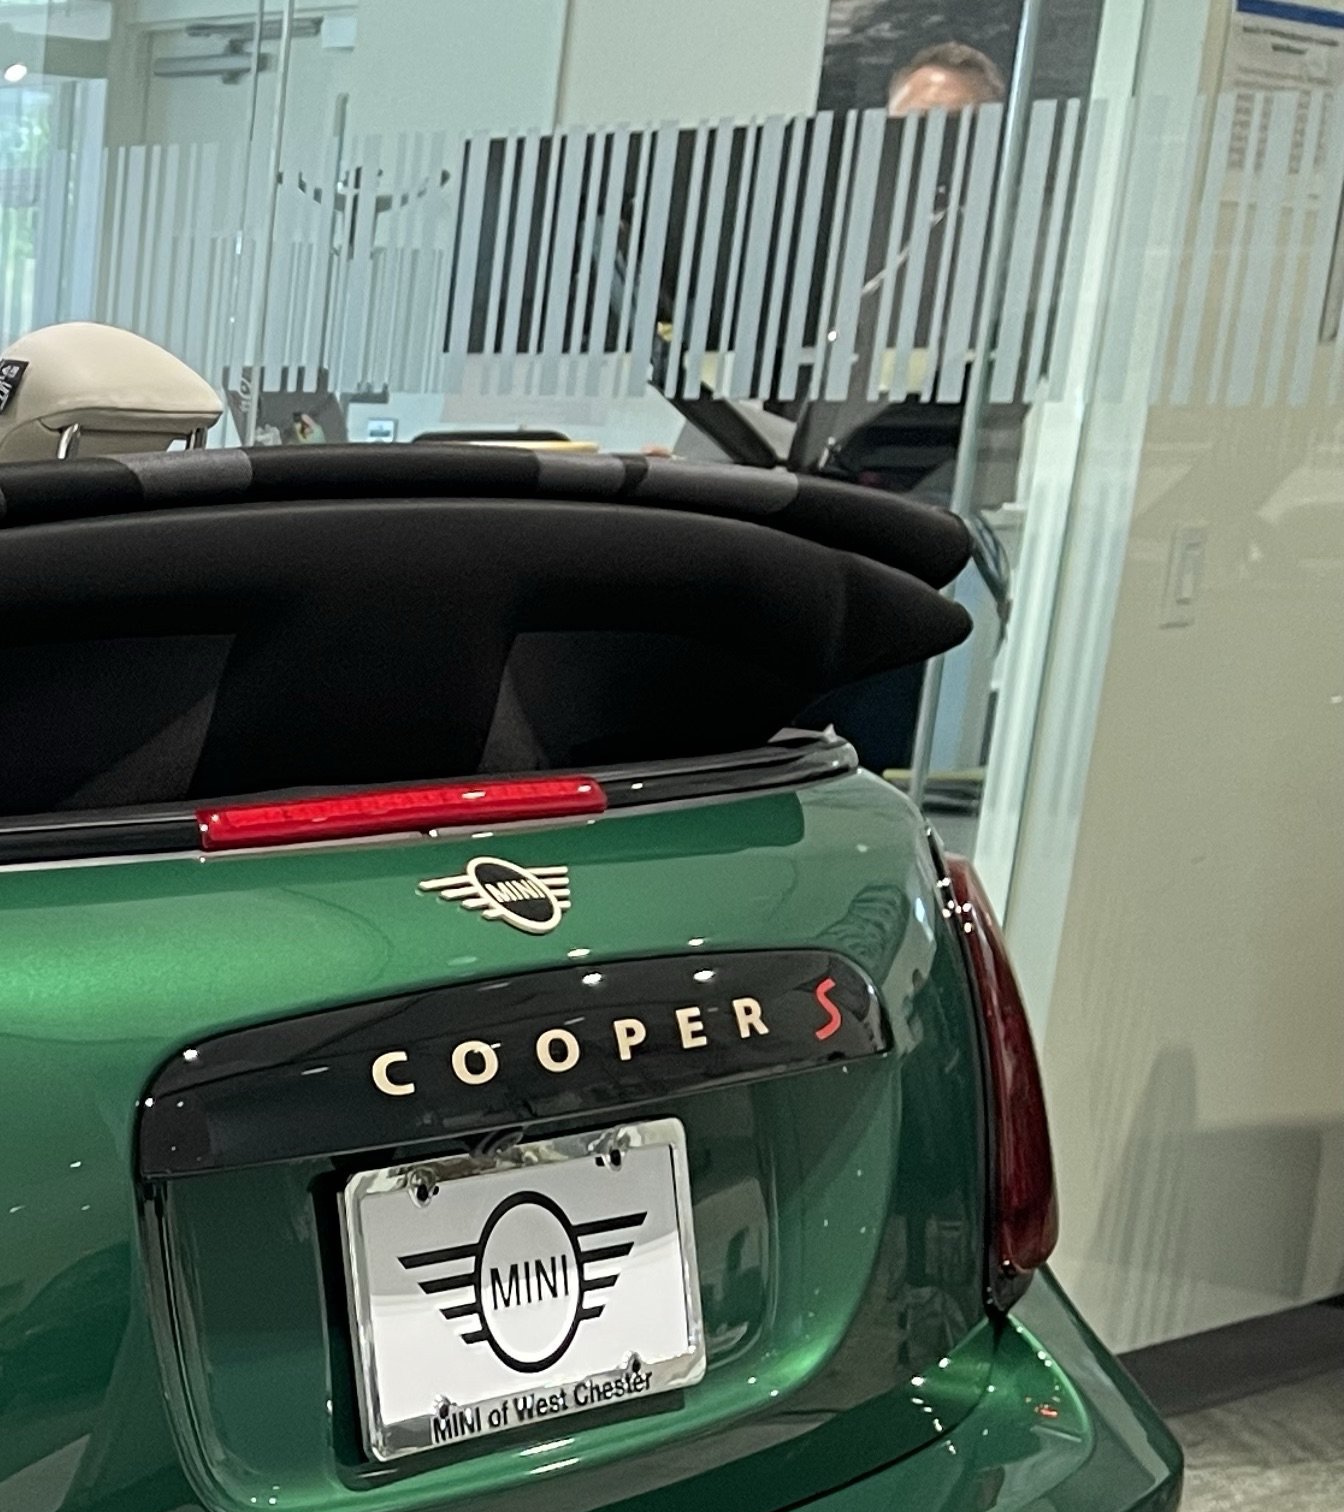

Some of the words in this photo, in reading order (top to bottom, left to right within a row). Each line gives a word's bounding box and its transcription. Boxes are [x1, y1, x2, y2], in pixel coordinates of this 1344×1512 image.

[484, 878, 547, 903] MINI
[372, 997, 769, 1097] COOPER
[815, 978, 843, 1041] S
[490, 1254, 570, 1310] MINI
[432, 1406, 482, 1444] MINI
[488, 1402, 509, 1429] of
[514, 1388, 569, 1422] West
[573, 1370, 653, 1407] Chester
